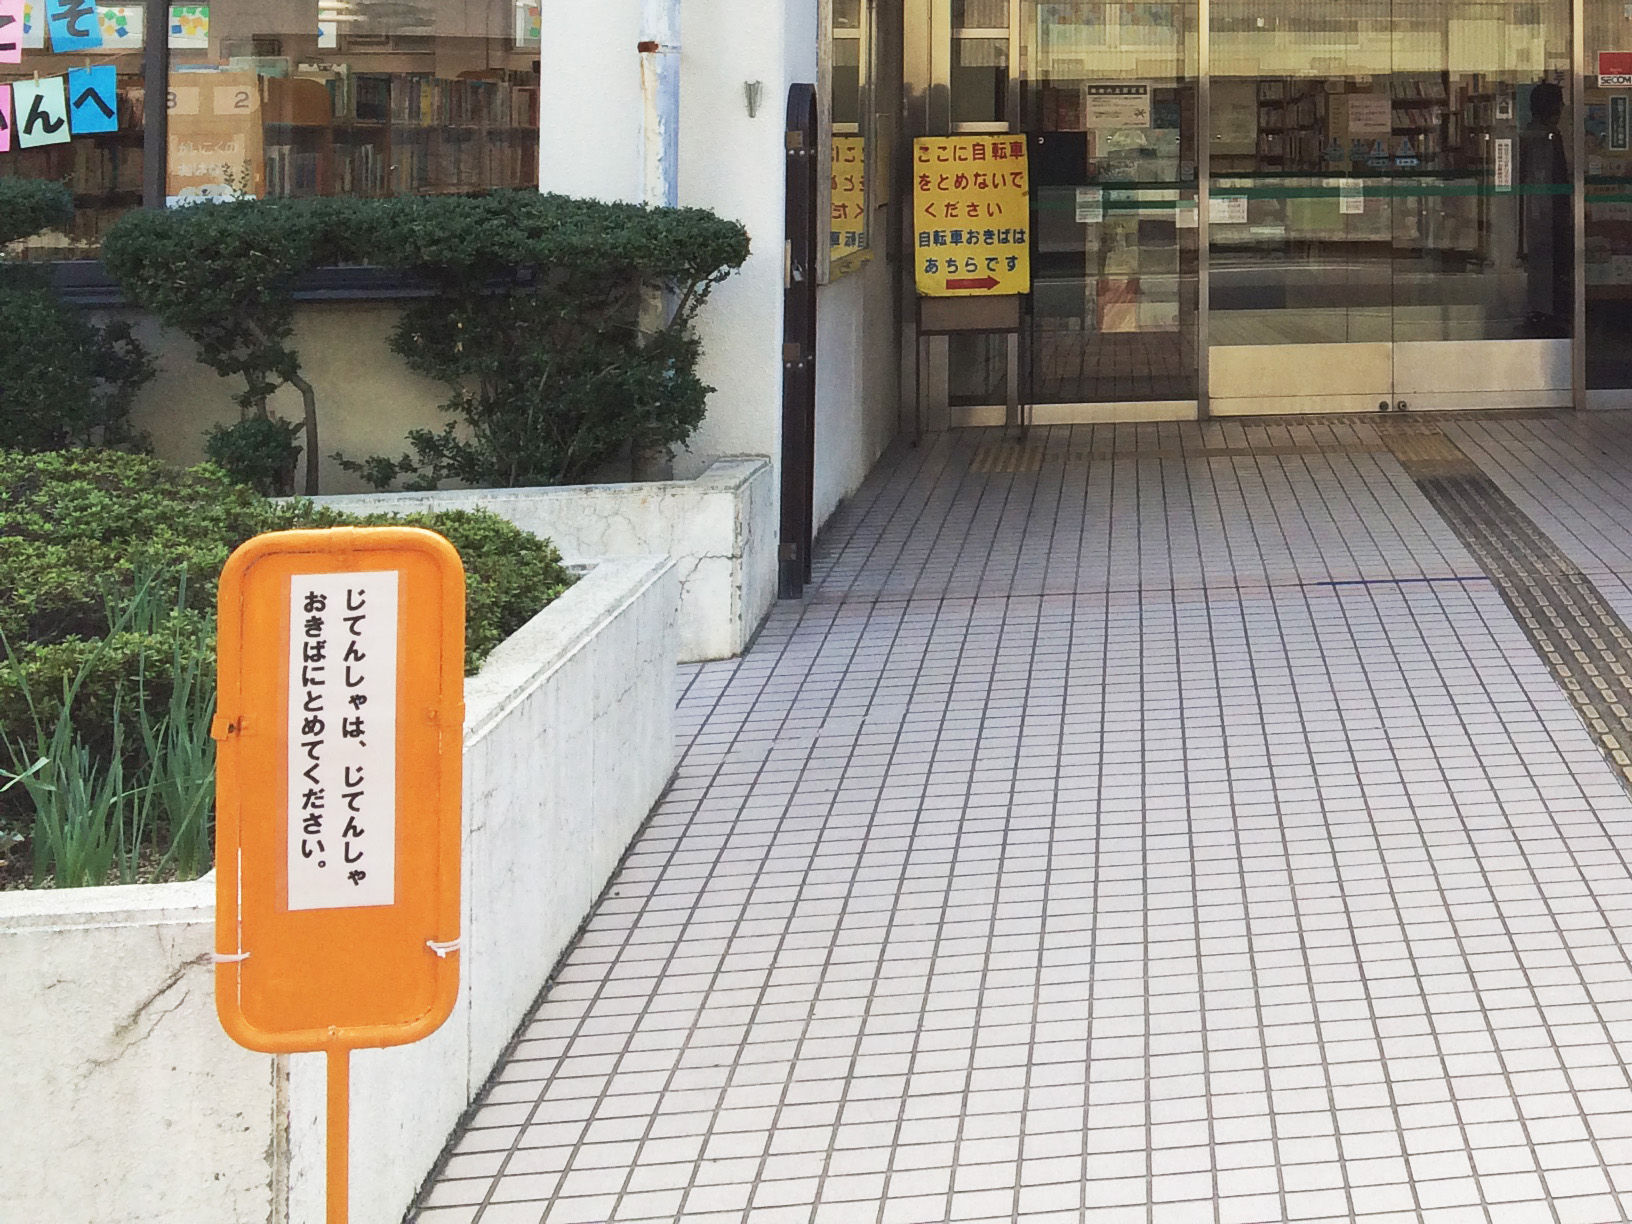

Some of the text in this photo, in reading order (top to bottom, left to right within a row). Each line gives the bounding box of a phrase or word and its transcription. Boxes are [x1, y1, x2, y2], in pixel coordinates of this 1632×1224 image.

[1600, 76, 1632, 85] SECOM
[234, 91, 249, 108] 2
[917, 141, 1025, 163] ここに自転車
[918, 171, 1024, 191] をとめないで
[924, 200, 1003, 219] ください
[918, 228, 1026, 248] 自転車おきばは
[924, 254, 1019, 274] あちらです
[300, 590, 328, 870] おきばにとめてください。
[342, 588, 368, 887] じてんしゃは、じてんしゃ
